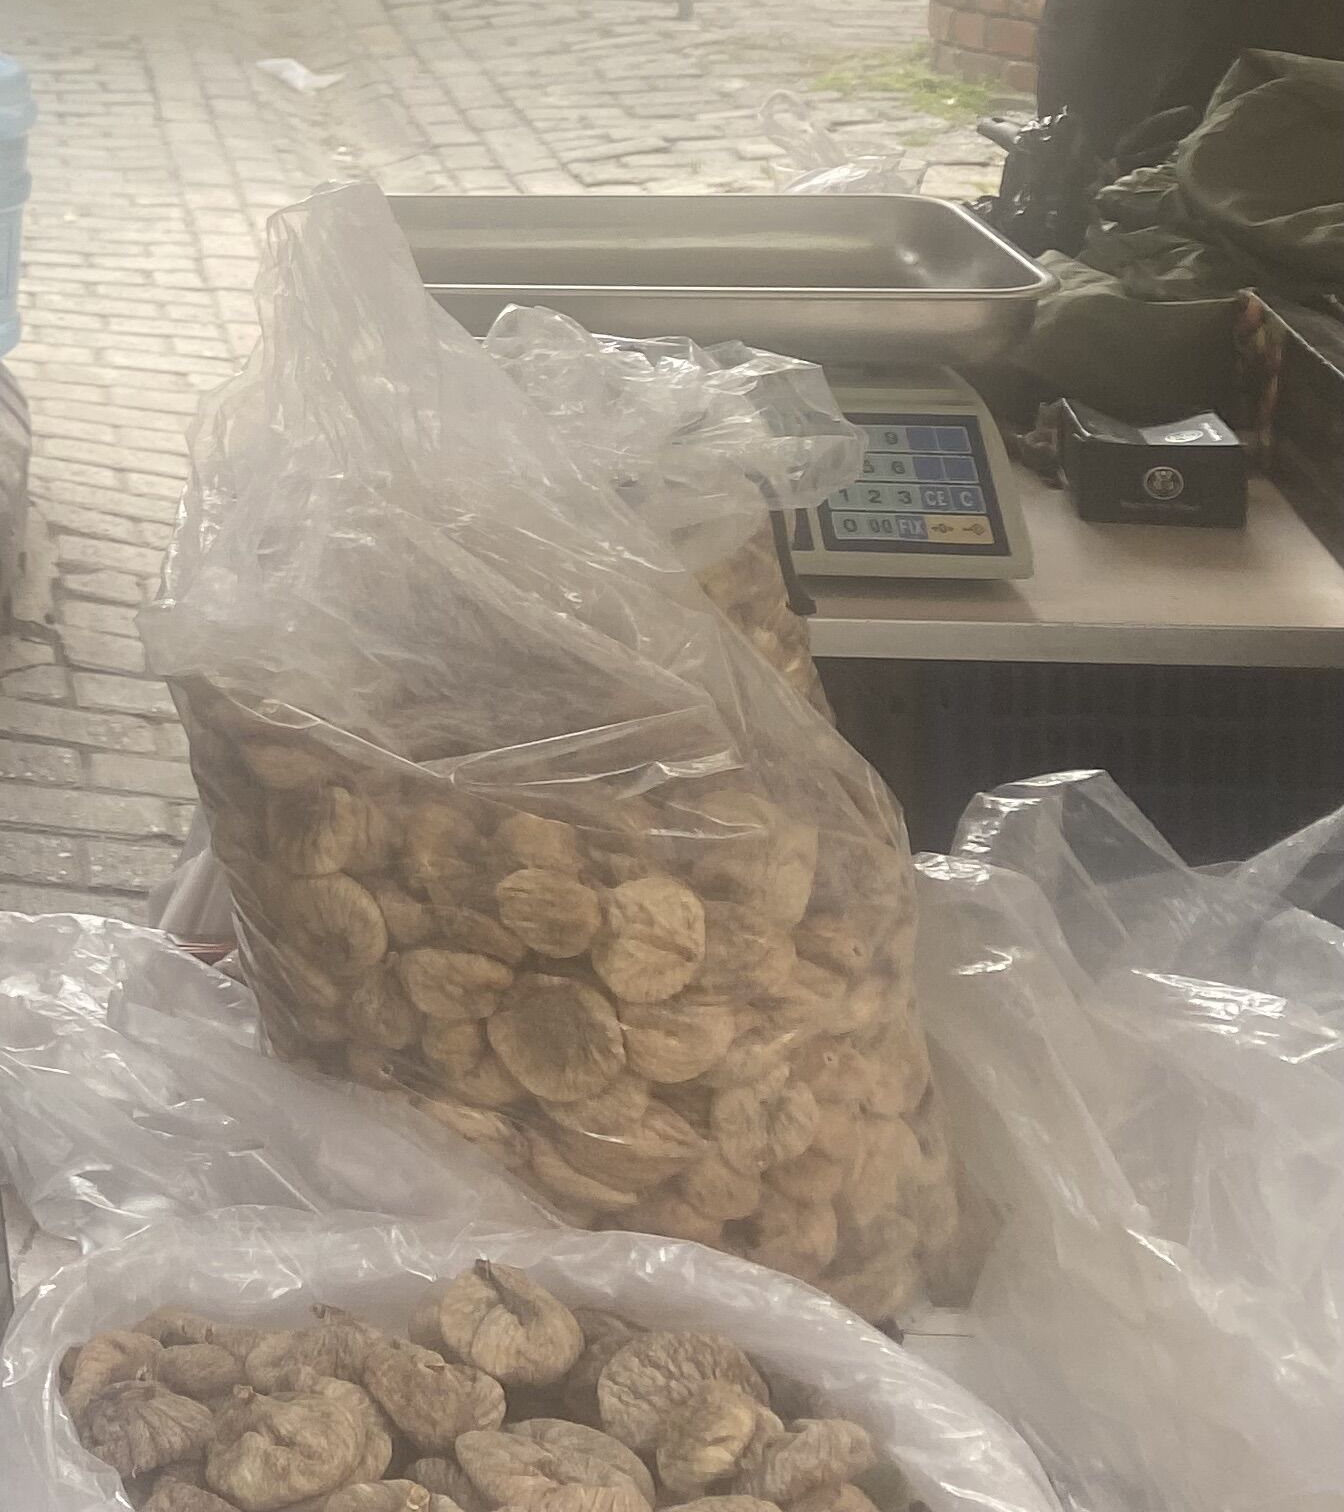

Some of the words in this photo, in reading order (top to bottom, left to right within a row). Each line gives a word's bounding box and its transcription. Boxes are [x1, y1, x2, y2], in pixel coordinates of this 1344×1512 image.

[868, 490, 882, 504] 2
[898, 490, 912, 505] 3
[924, 491, 946, 506] CE
[959, 491, 973, 507] C
